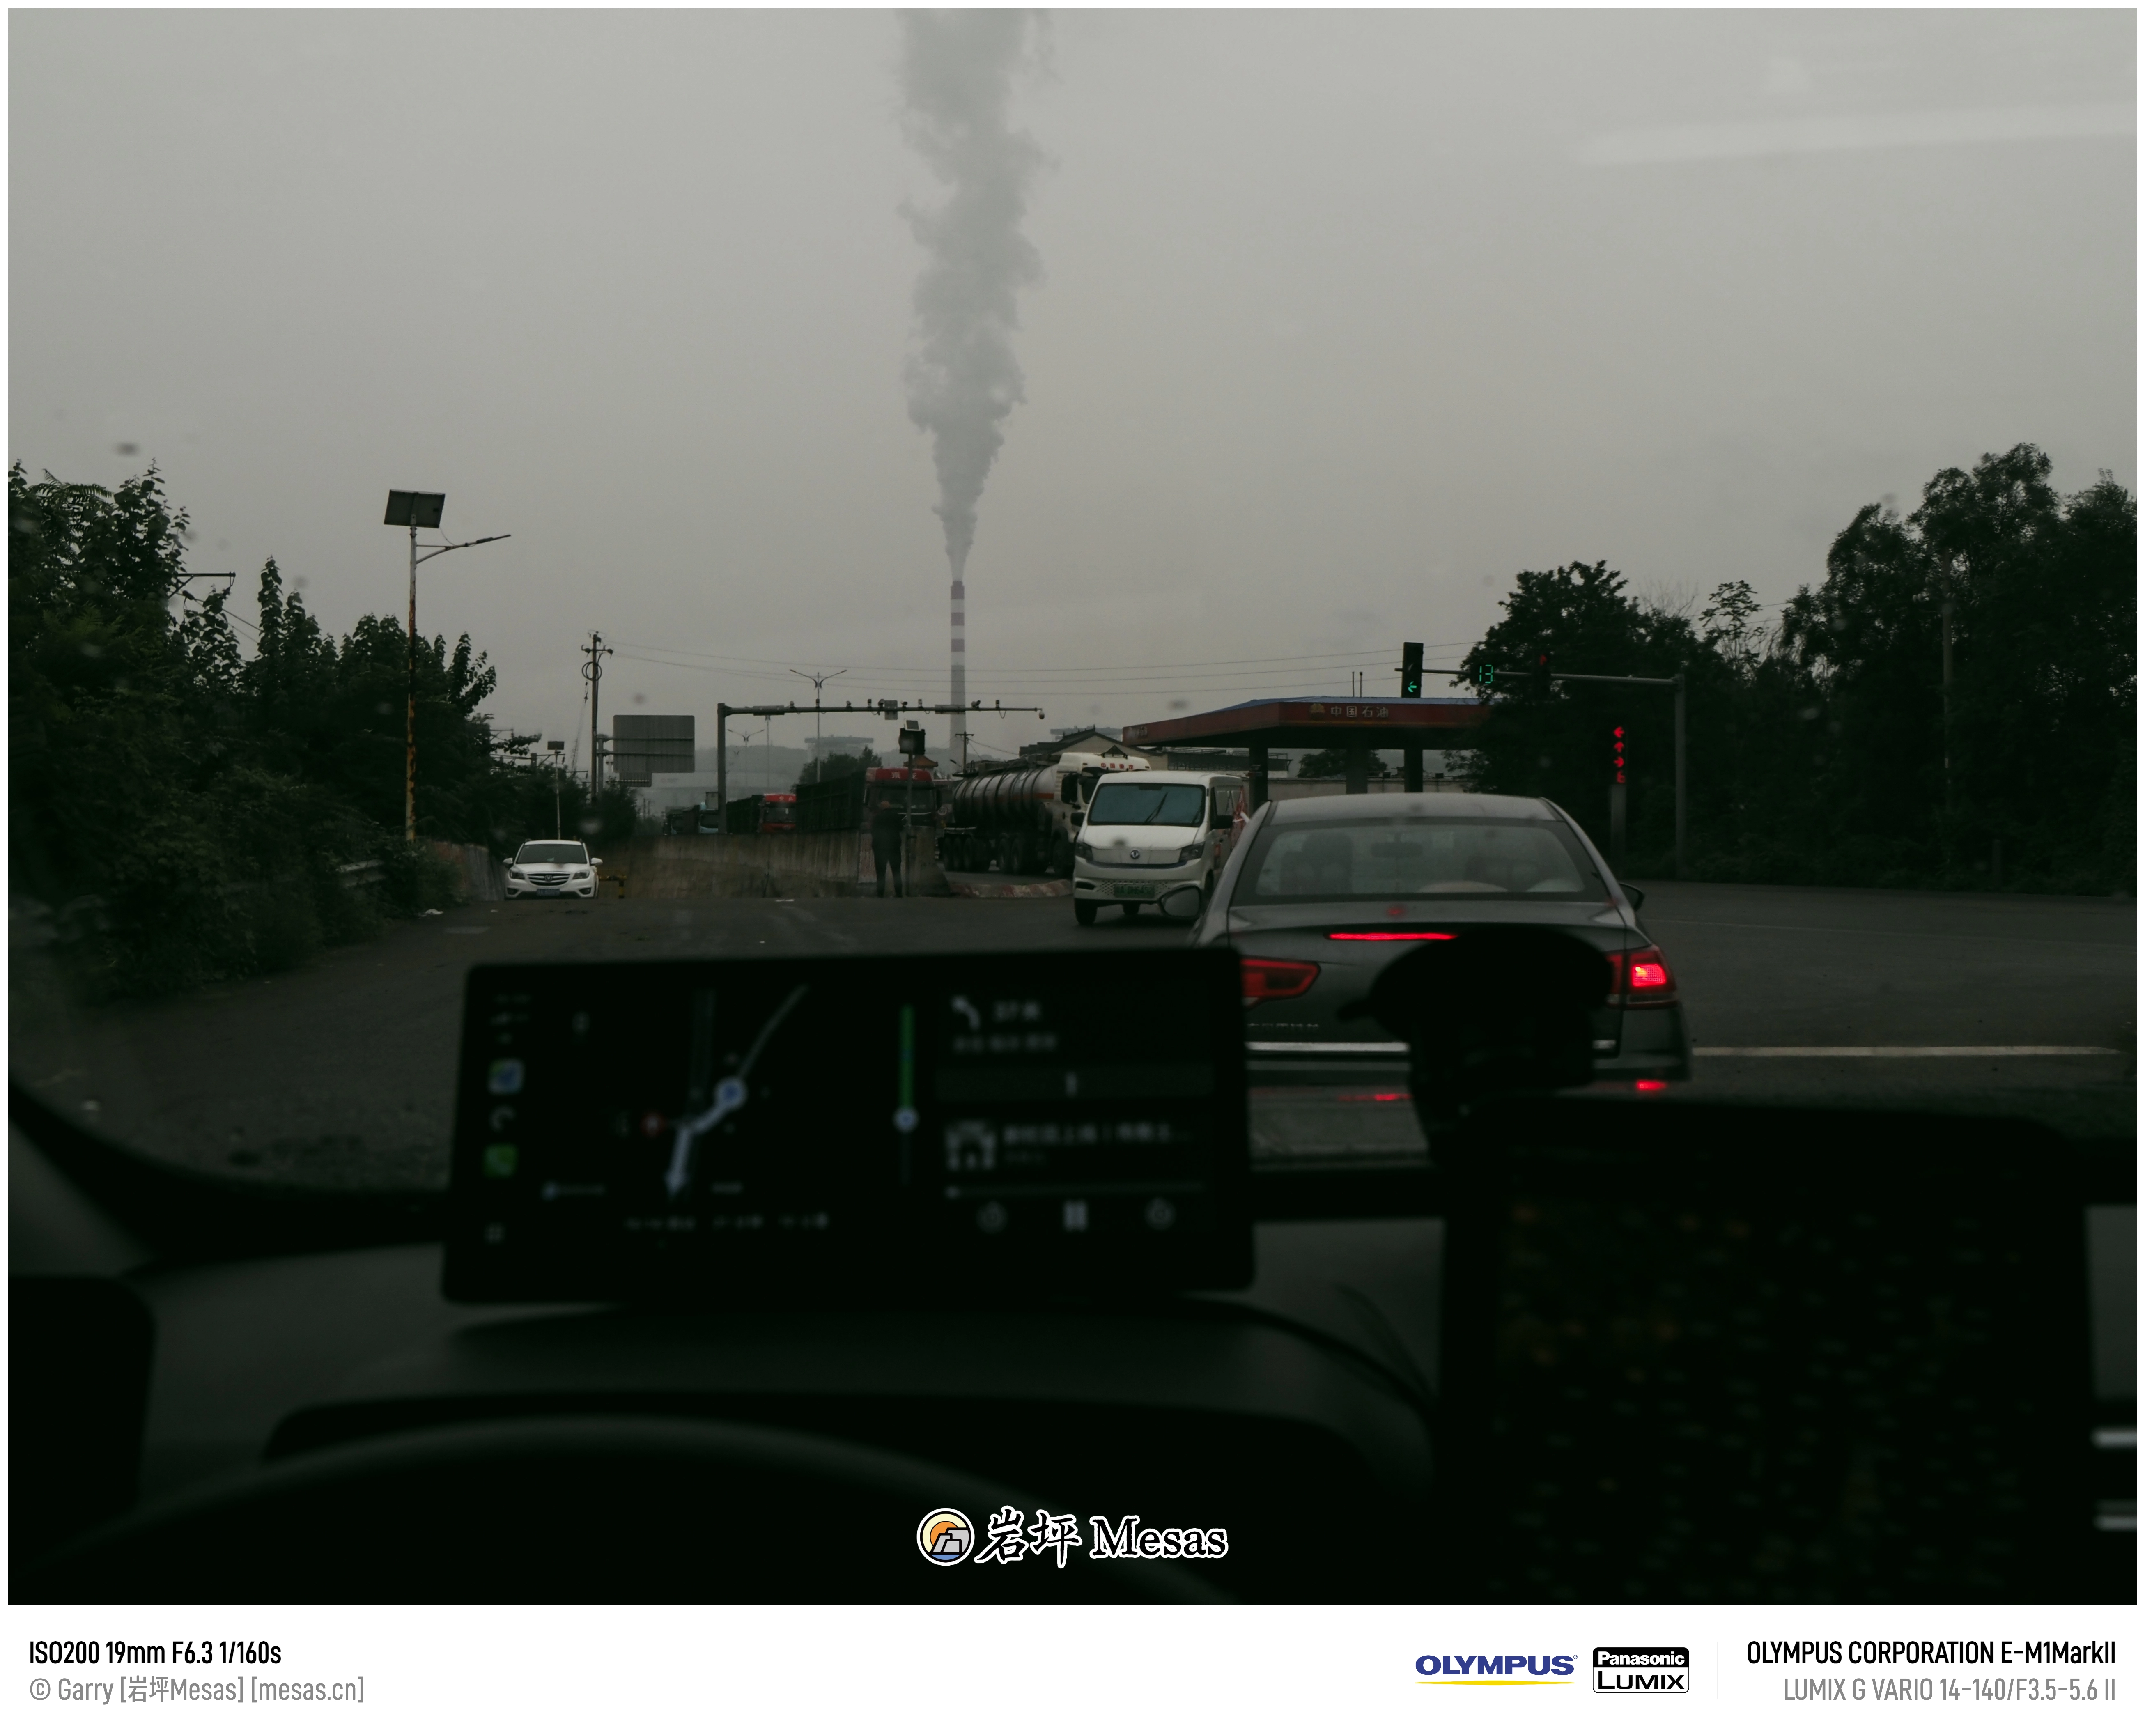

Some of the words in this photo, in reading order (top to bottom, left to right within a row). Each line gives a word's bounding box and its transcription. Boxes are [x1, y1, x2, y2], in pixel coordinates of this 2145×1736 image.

[1479, 664, 1494, 684] 13
[1330, 705, 1389, 718] 中国石油
